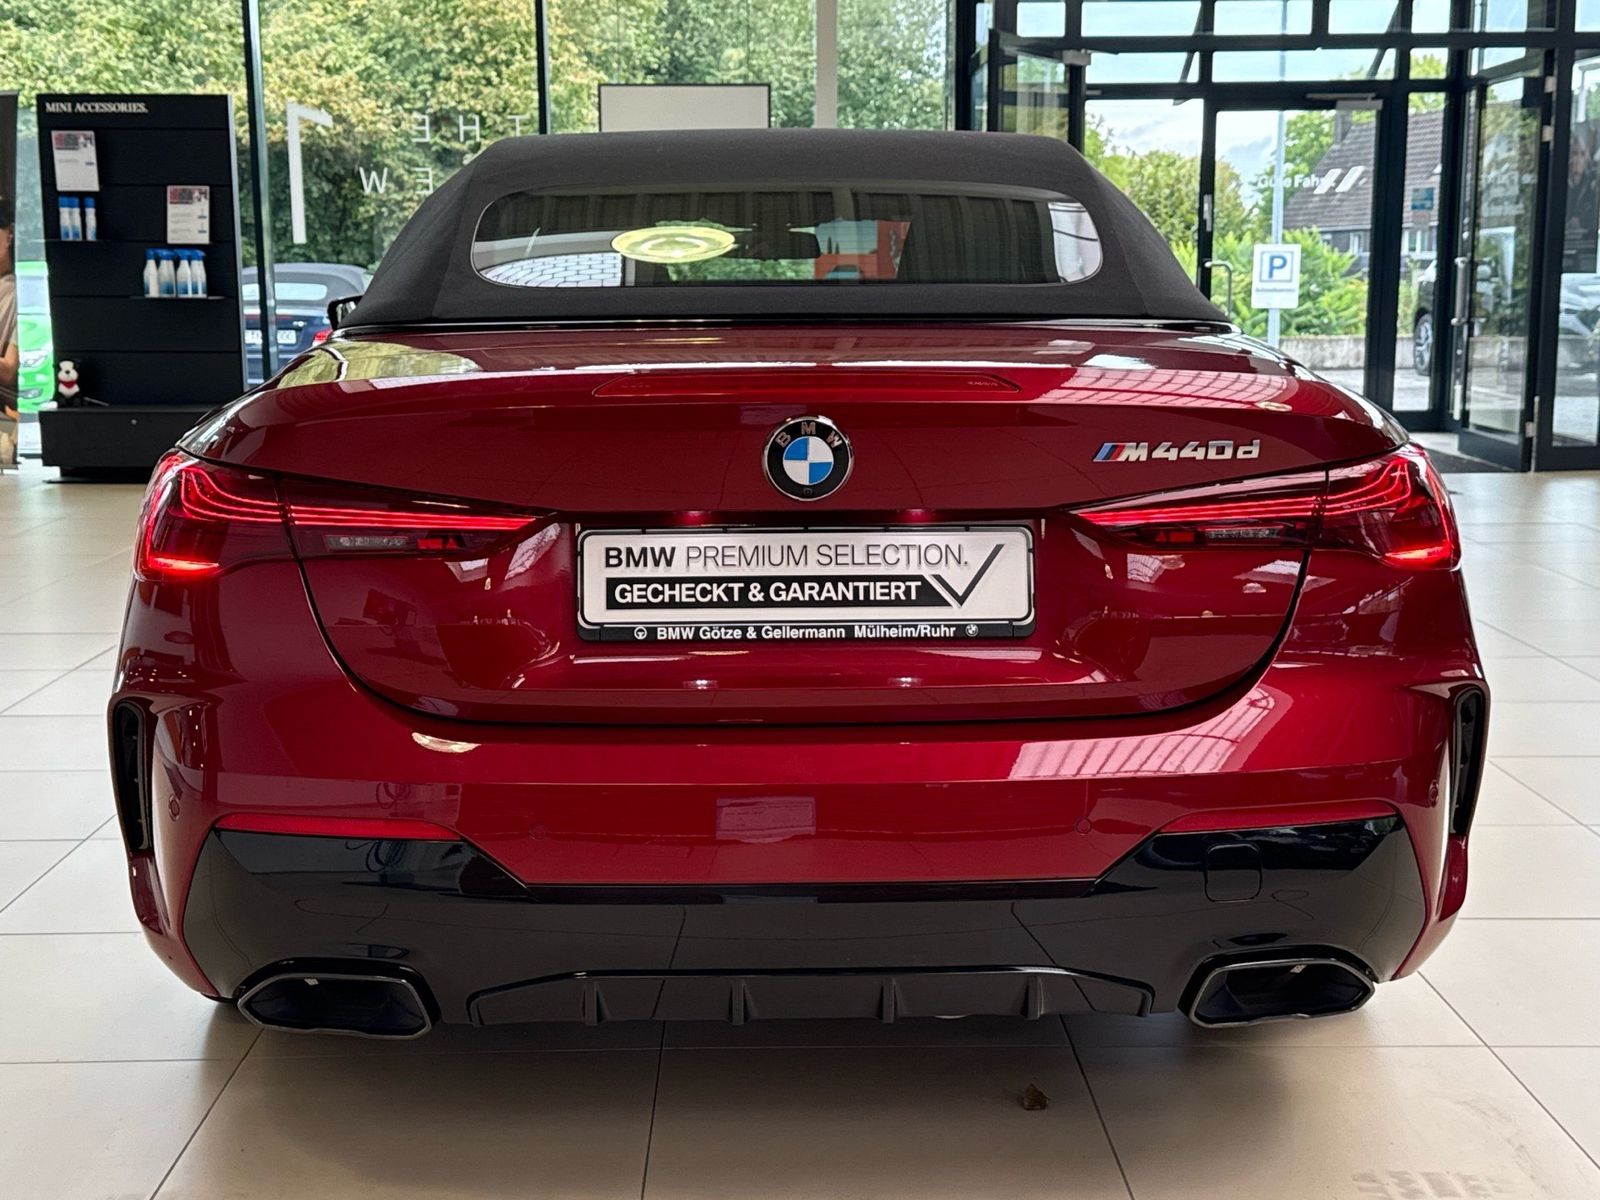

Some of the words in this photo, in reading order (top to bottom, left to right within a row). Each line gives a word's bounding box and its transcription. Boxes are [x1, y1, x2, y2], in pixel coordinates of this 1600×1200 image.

[45, 102, 72, 113] MINI
[74, 102, 149, 113] ACCESSORIES.
[1268, 255, 1287, 279] P
[775, 422, 843, 448] BMW
[605, 546, 676, 568] BMW
[686, 545, 808, 568] PREMIUM
[816, 544, 969, 566] SELECTION.
[614, 583, 745, 603] GECHECKT
[747, 583, 764, 602] &
[769, 581, 922, 602] GARANTIERT
[656, 627, 695, 640] BMW
[699, 626, 742, 640] Götze
[746, 627, 757, 640] &
[761, 625, 846, 640] Gellermann
[854, 624, 957, 639] Mülheim/Ruhr
